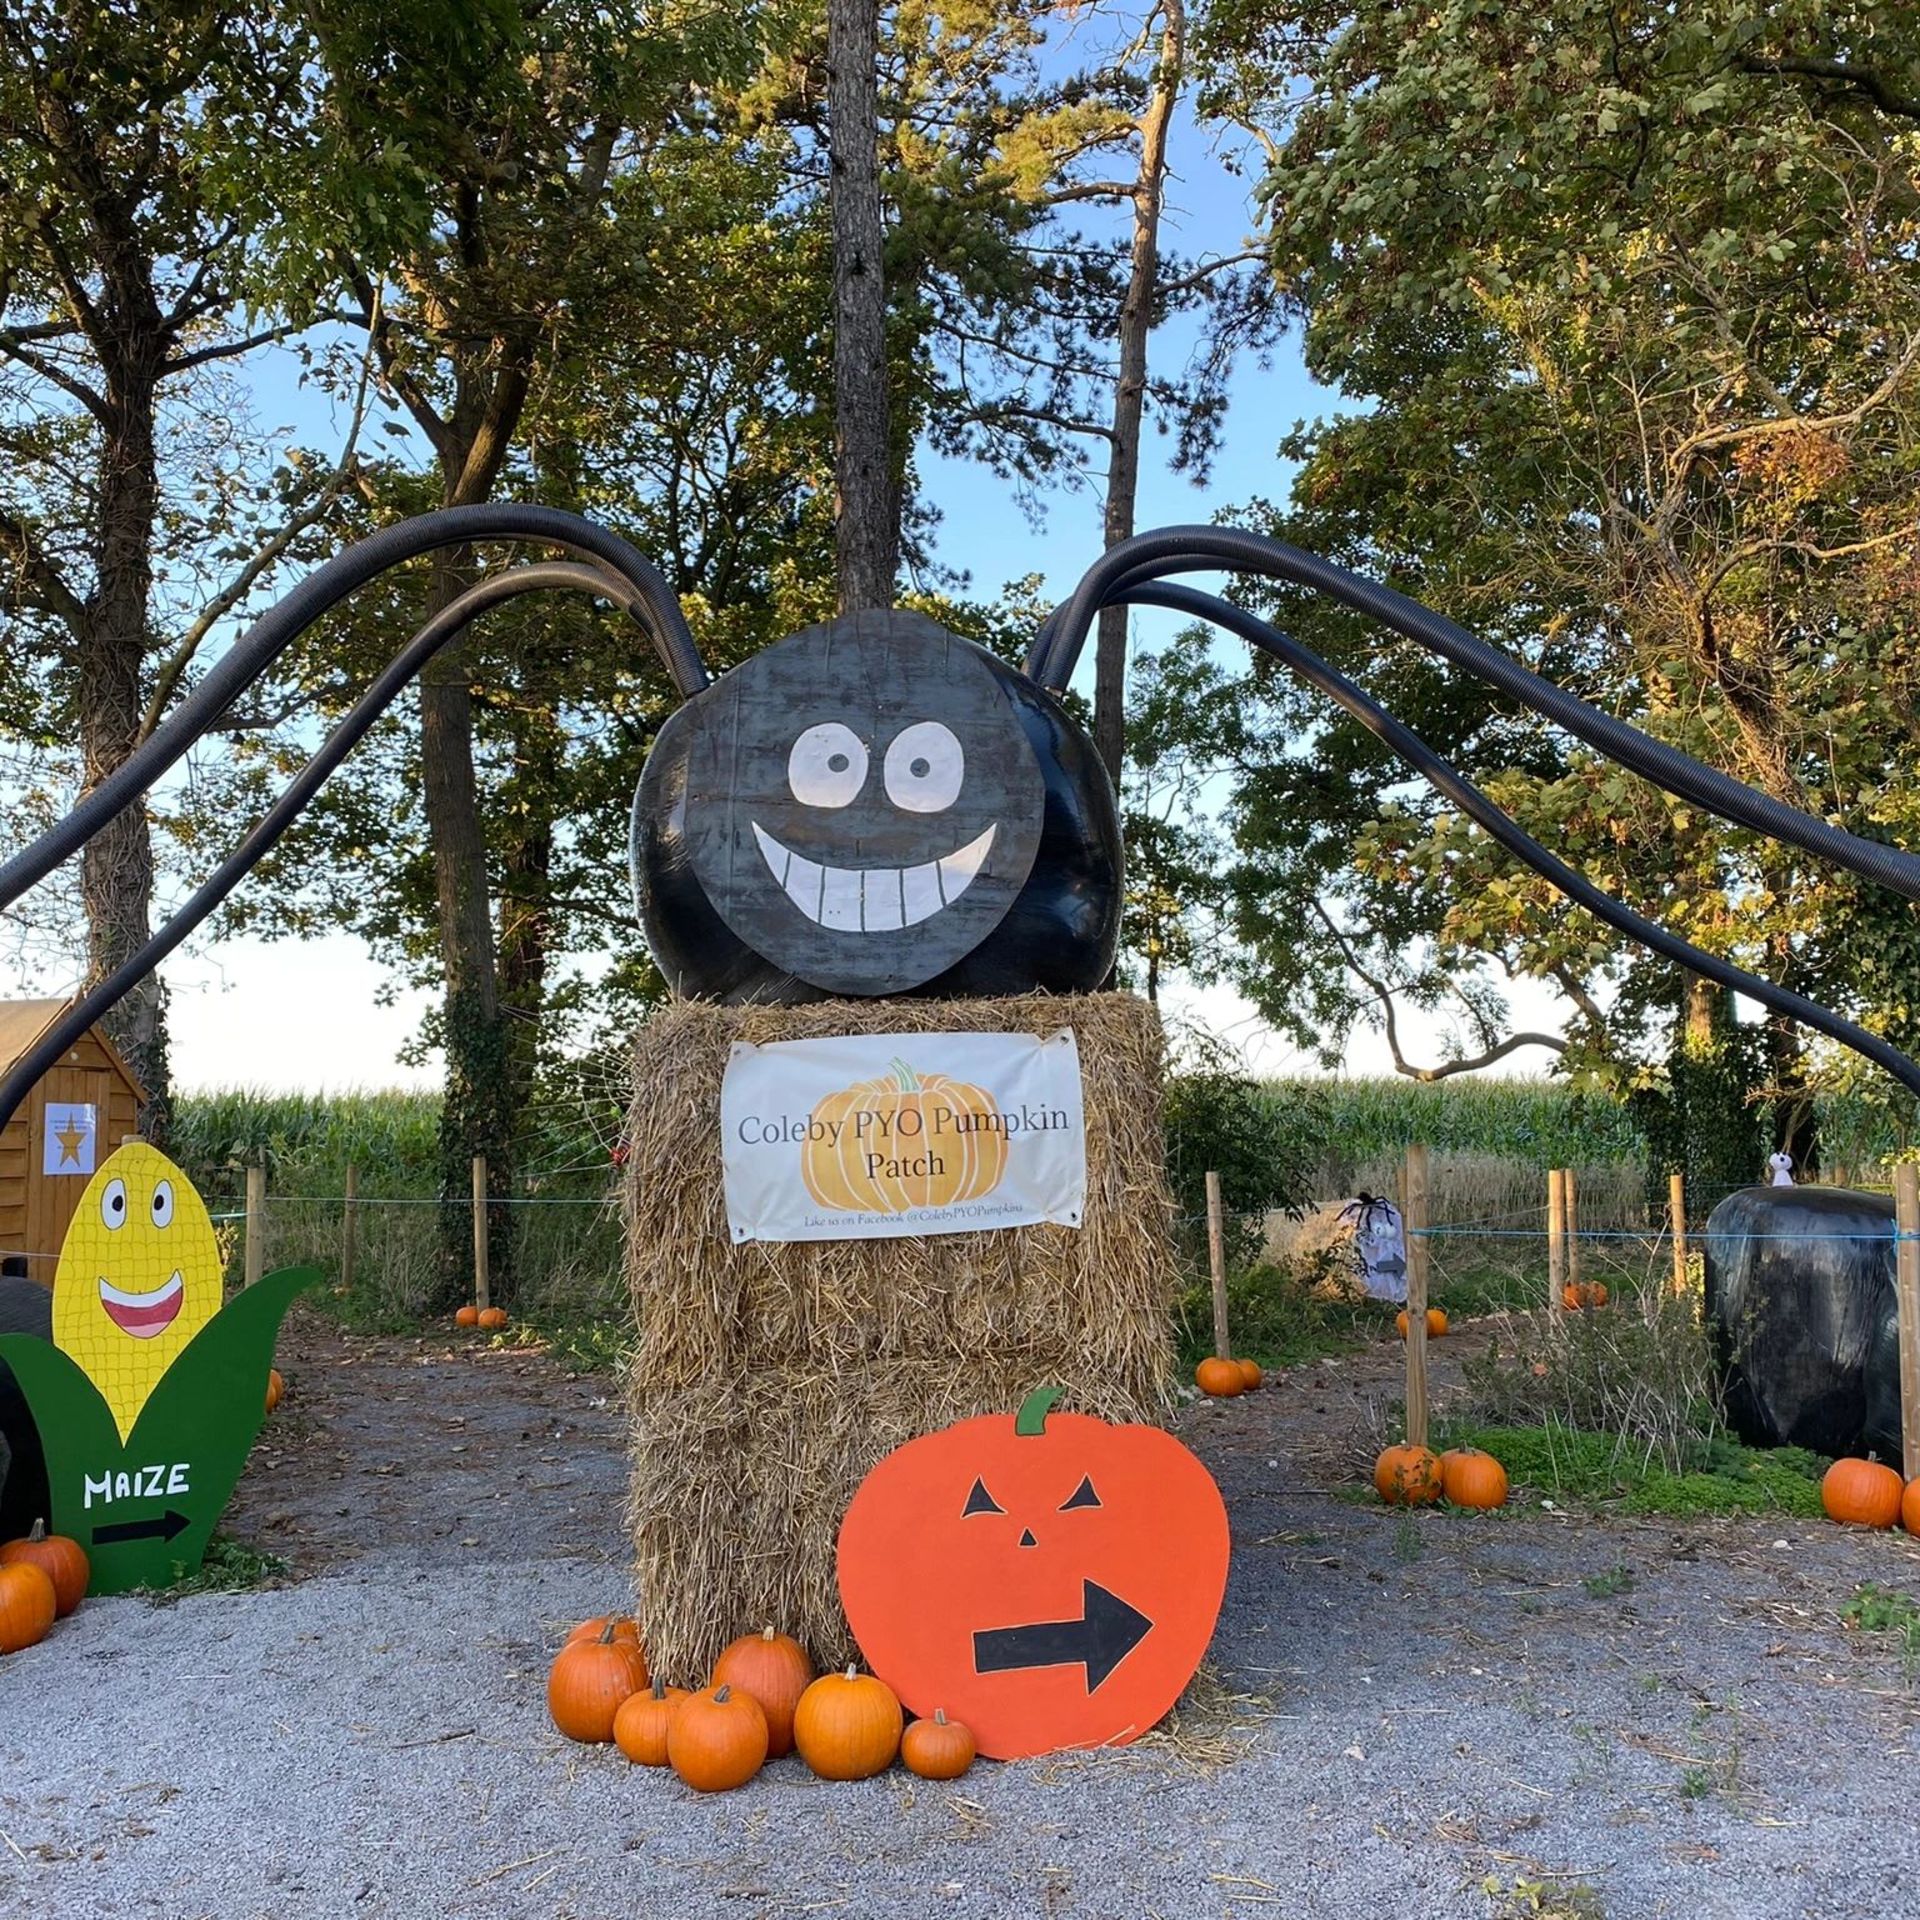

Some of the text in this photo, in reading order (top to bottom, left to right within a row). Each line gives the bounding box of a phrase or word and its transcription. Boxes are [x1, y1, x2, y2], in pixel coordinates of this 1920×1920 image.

[738, 1103, 1070, 1148] Coleby PYO Pumpkin
[866, 1150, 946, 1180] Patch
[804, 1216, 826, 1227] Like
[857, 1211, 905, 1225] Facebook
[84, 1463, 191, 1510] MAIZE
